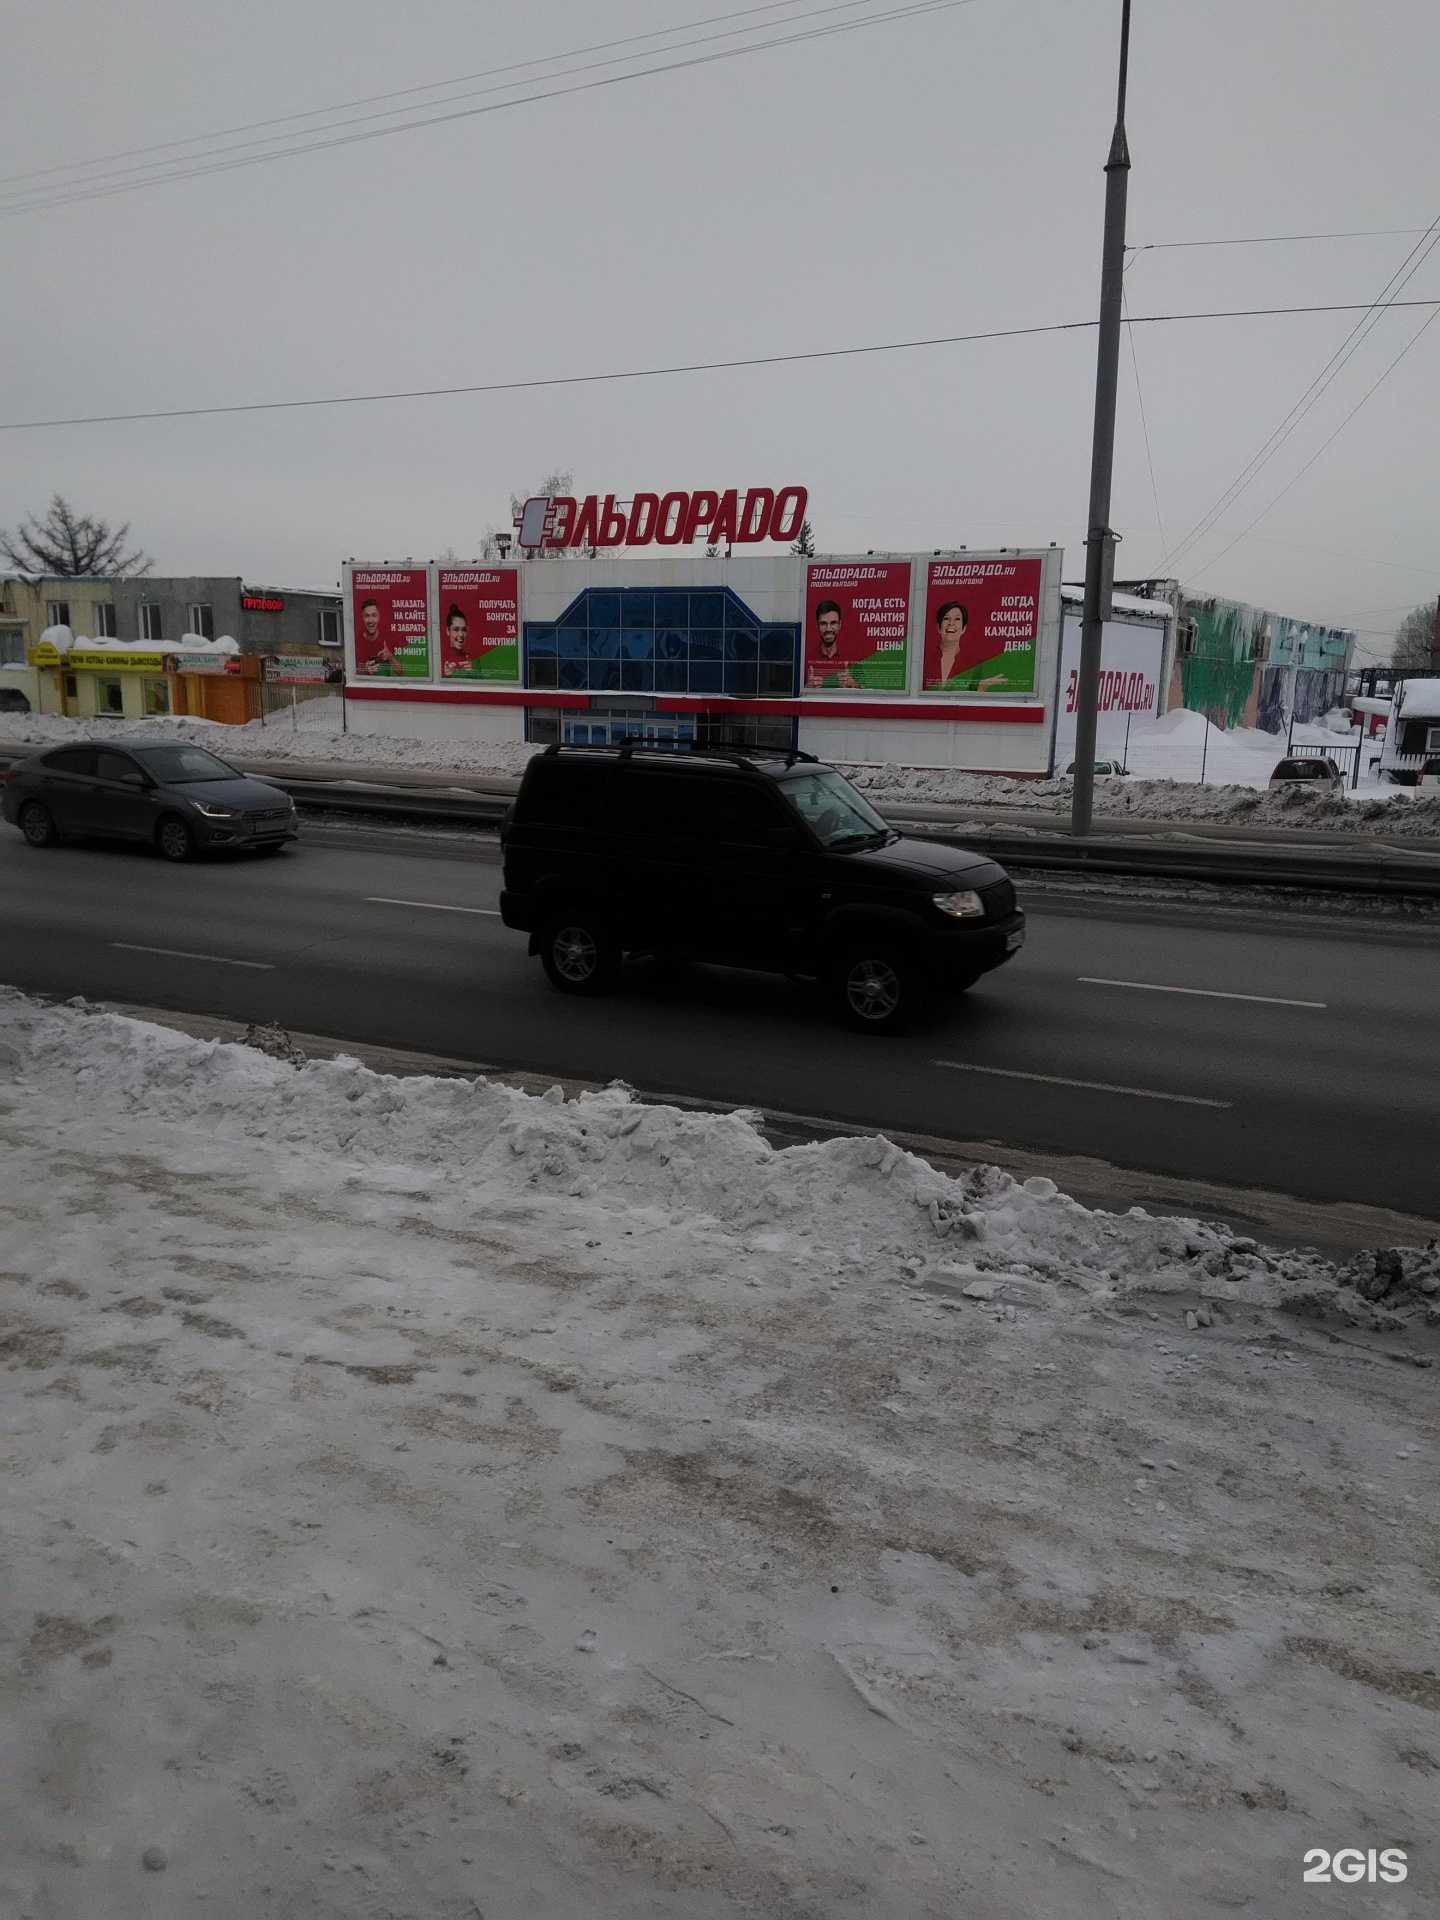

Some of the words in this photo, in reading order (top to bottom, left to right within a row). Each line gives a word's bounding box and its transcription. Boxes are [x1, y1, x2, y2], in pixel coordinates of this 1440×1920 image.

[391, 600, 425, 608] ЗАКАЗАТЬ
[479, 600, 516, 609] ПОЛУЧАТЬ
[852, 598, 882, 609] КОГДА
[883, 597, 906, 608] ЕСТЬ
[1001, 596, 1034, 607] КОГДА
[394, 611, 404, 620] НА
[404, 610, 426, 620] САЙТЕ
[486, 612, 515, 621] БОНУСЫ
[859, 611, 905, 623] ГАРАНТИЯ
[990, 610, 1033, 622] СКИДКИ
[397, 624, 426, 632] ЗАБРАТЬ
[506, 626, 516, 634] ЗА
[867, 625, 905, 637] НИЗКОЙ
[984, 625, 1032, 637] КАЖДЫЙ
[405, 636, 426, 644] ЧЕРЕЗ
[482, 637, 516, 646] ПОКУПКИ
[876, 641, 904, 652] ЦЕНЫ
[1003, 640, 1032, 652] ДЕНЬ
[403, 648, 426, 656] МИНУТ
